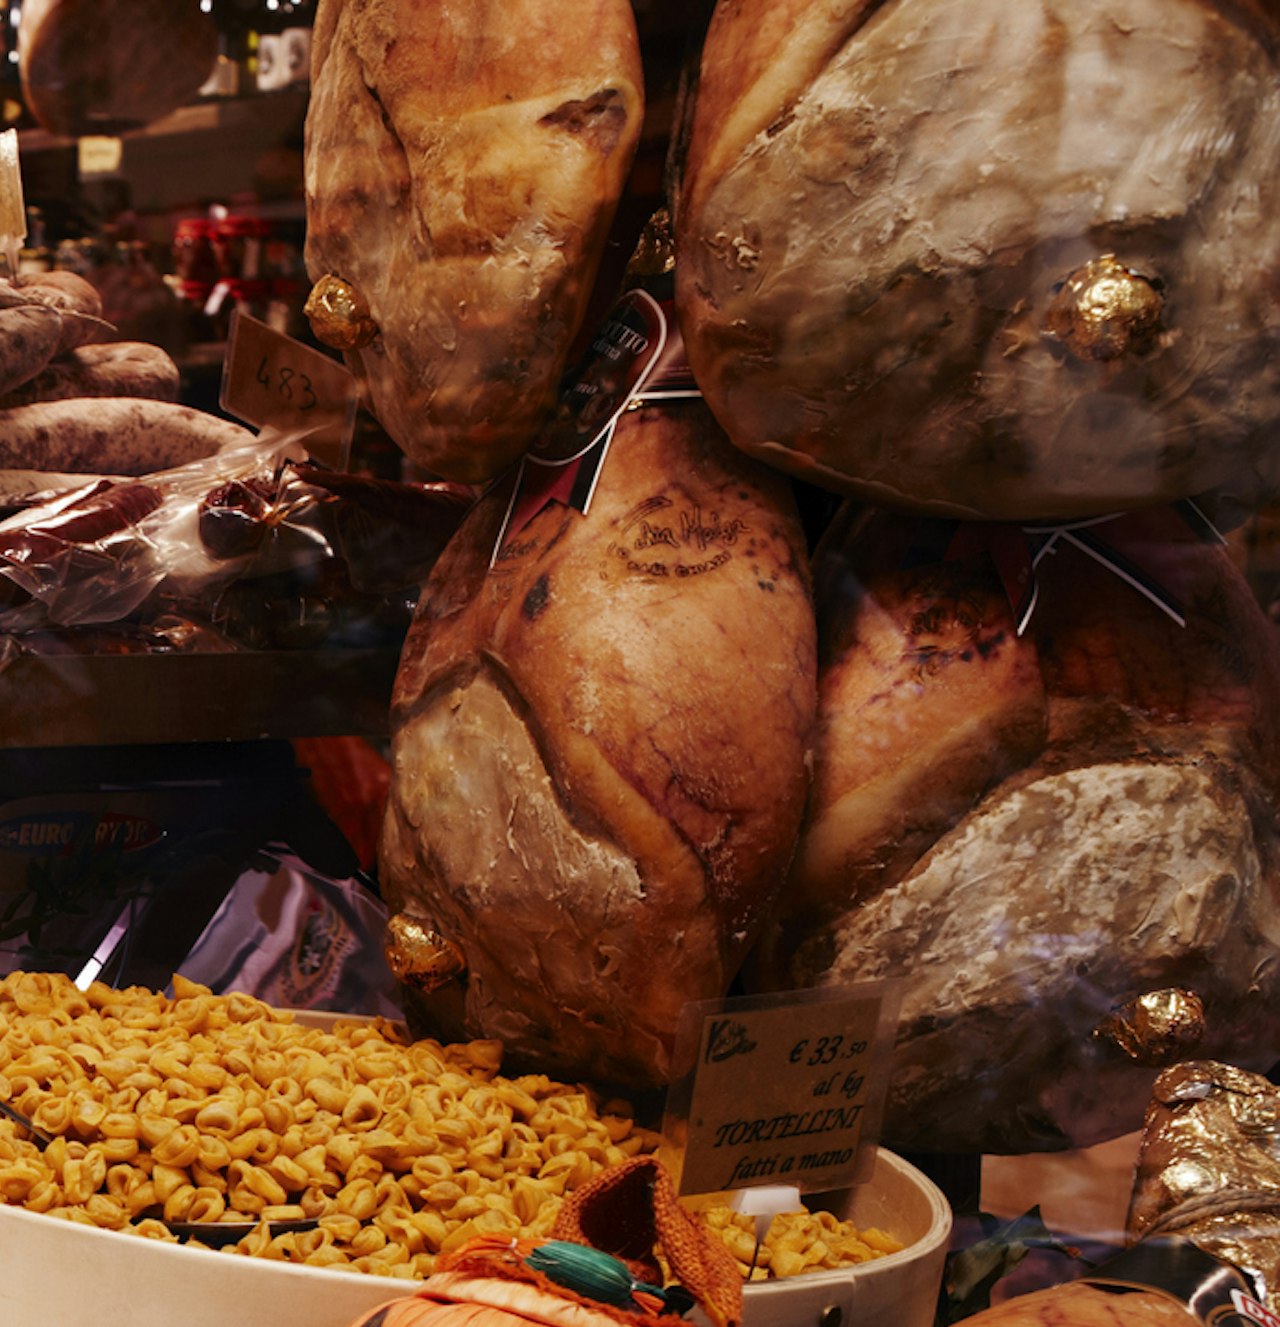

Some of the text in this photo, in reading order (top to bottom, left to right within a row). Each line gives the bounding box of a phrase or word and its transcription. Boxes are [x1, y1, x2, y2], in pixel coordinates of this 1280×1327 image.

[256, 355, 317, 411] 483
[789, 1038, 810, 1064] €
[812, 1069, 866, 1100] al kg
[712, 1104, 865, 1149] TORTELLINI
[720, 1148, 854, 1192] fatti a mano
